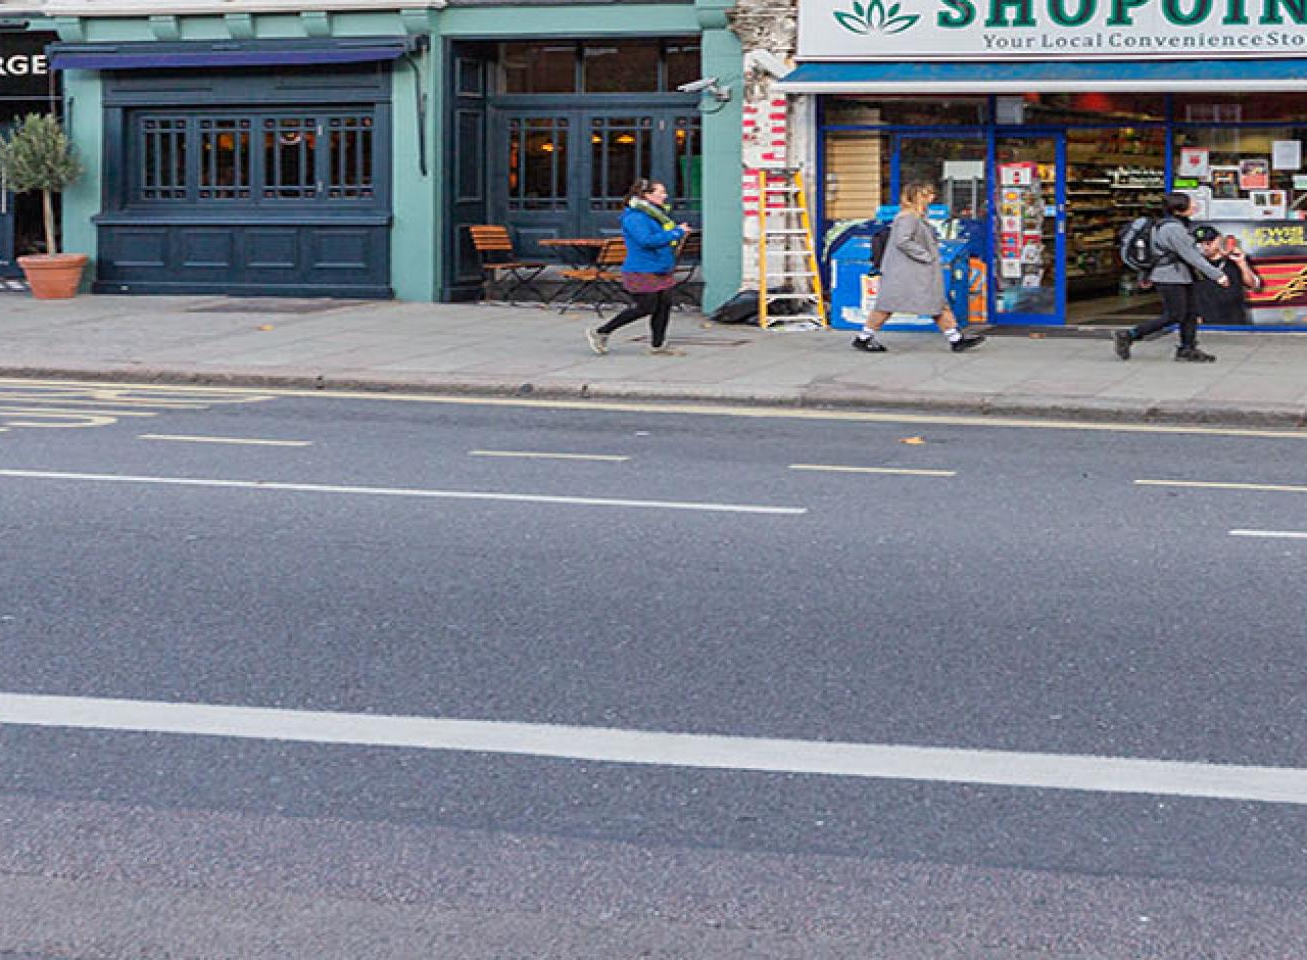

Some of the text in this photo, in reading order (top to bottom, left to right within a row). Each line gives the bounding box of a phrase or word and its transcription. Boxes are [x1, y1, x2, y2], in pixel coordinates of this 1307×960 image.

[983, 34, 1035, 49] Your
[1041, 33, 1103, 48] Local
[1108, 33, 1263, 48] Convenience
